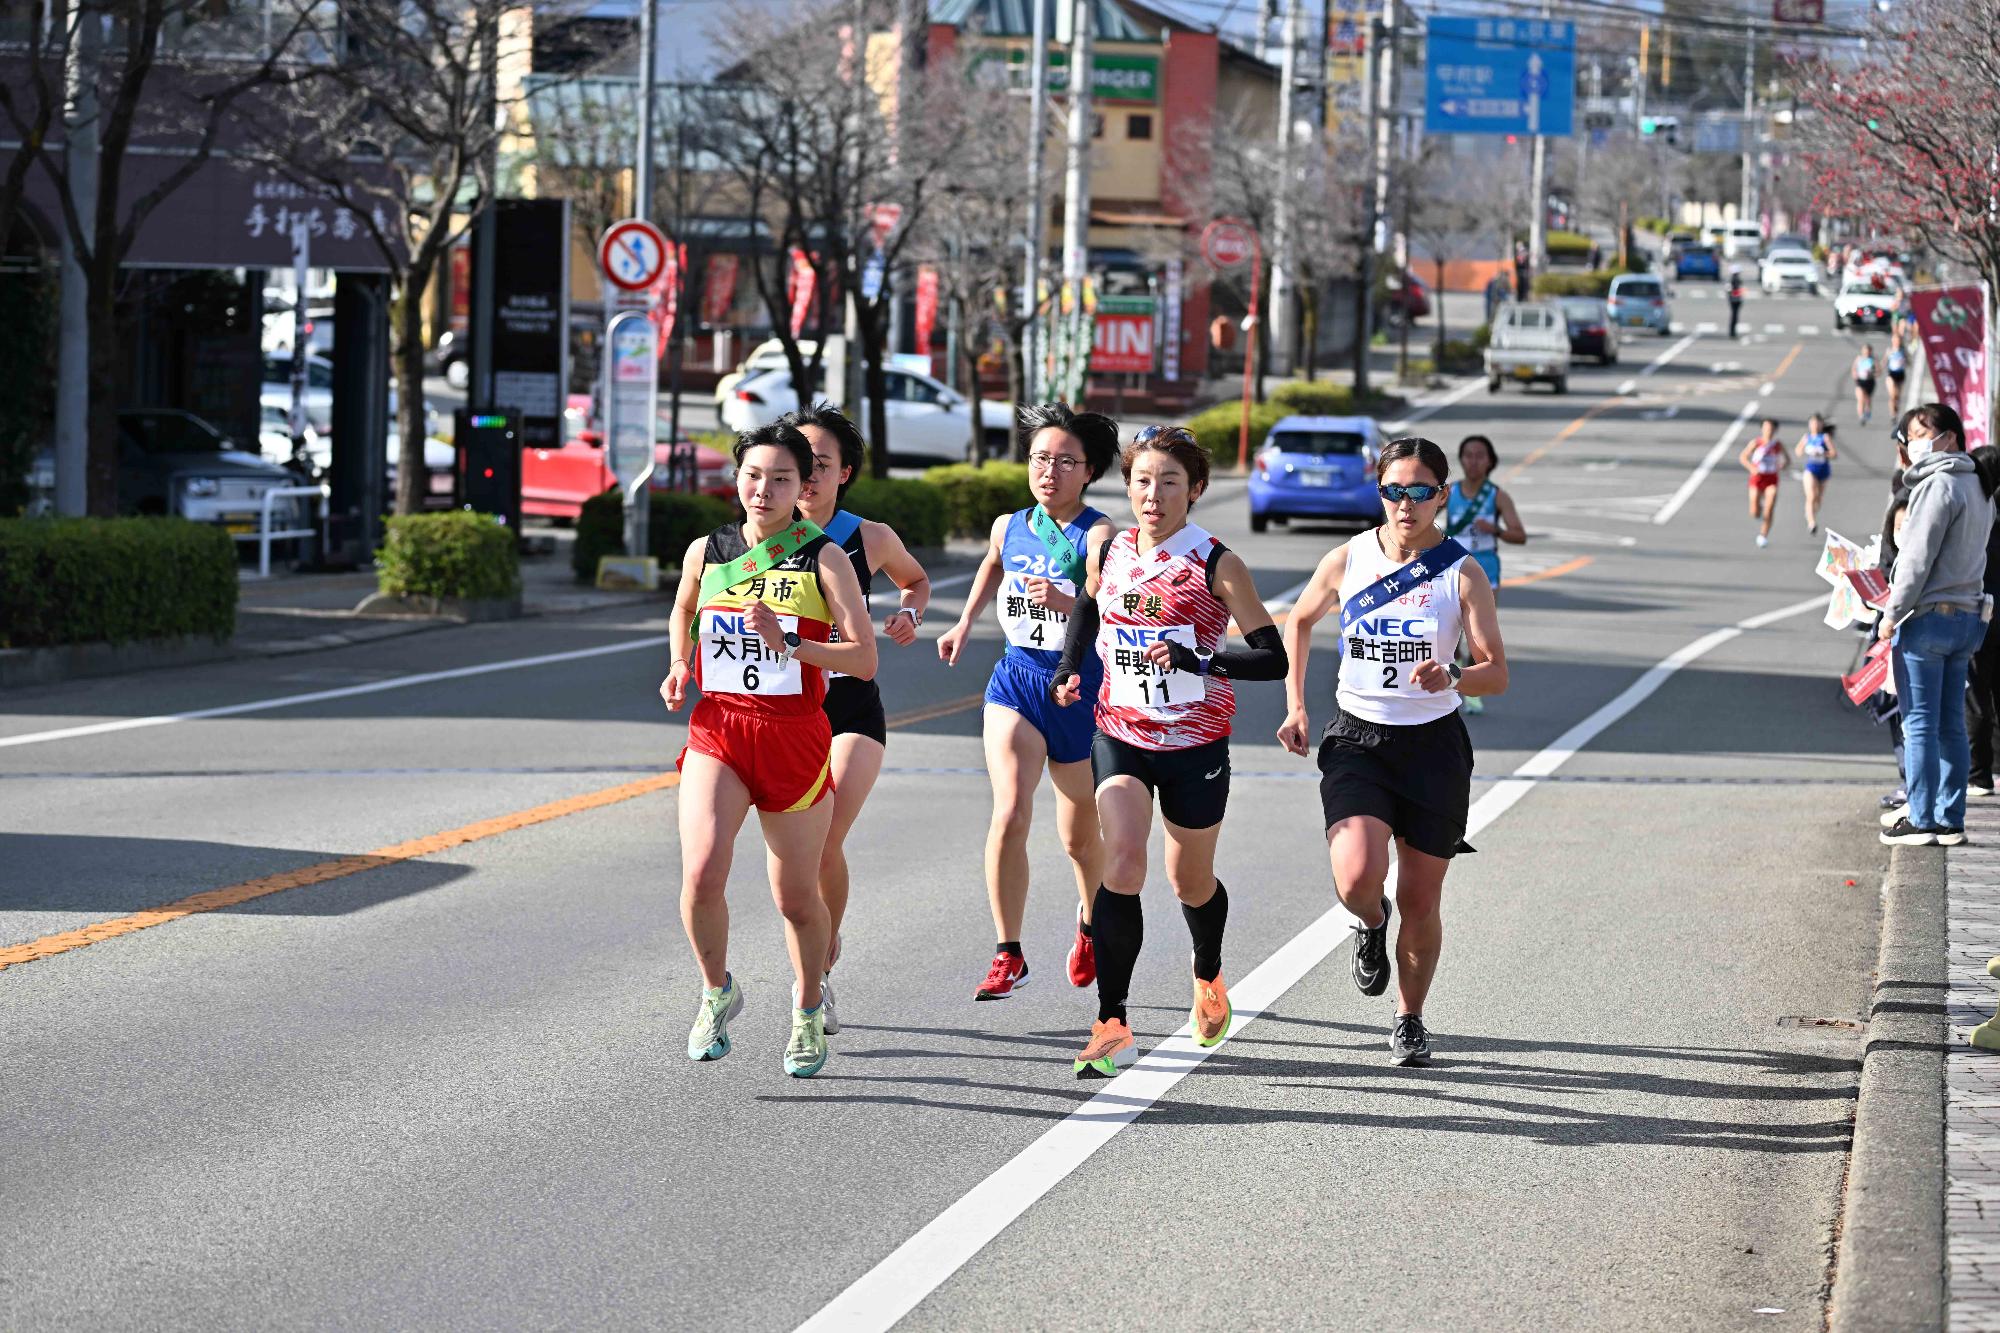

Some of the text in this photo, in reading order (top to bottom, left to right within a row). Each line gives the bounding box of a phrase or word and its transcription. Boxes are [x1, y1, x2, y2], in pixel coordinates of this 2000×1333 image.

[741, 527, 807, 573] 大月市
[1011, 555, 1064, 577] つるし
[1106, 550, 1171, 595] 甲斐市
[725, 577, 798, 603] 月市
[1123, 593, 1162, 620] 甲斐
[1030, 623, 1044, 646] 4
[1355, 618, 1425, 639] NEC
[1348, 637, 1432, 664] 富士吉田市
[743, 665, 760, 690] 6
[1382, 666, 1399, 689] 2
[1139, 679, 1171, 704] 11
